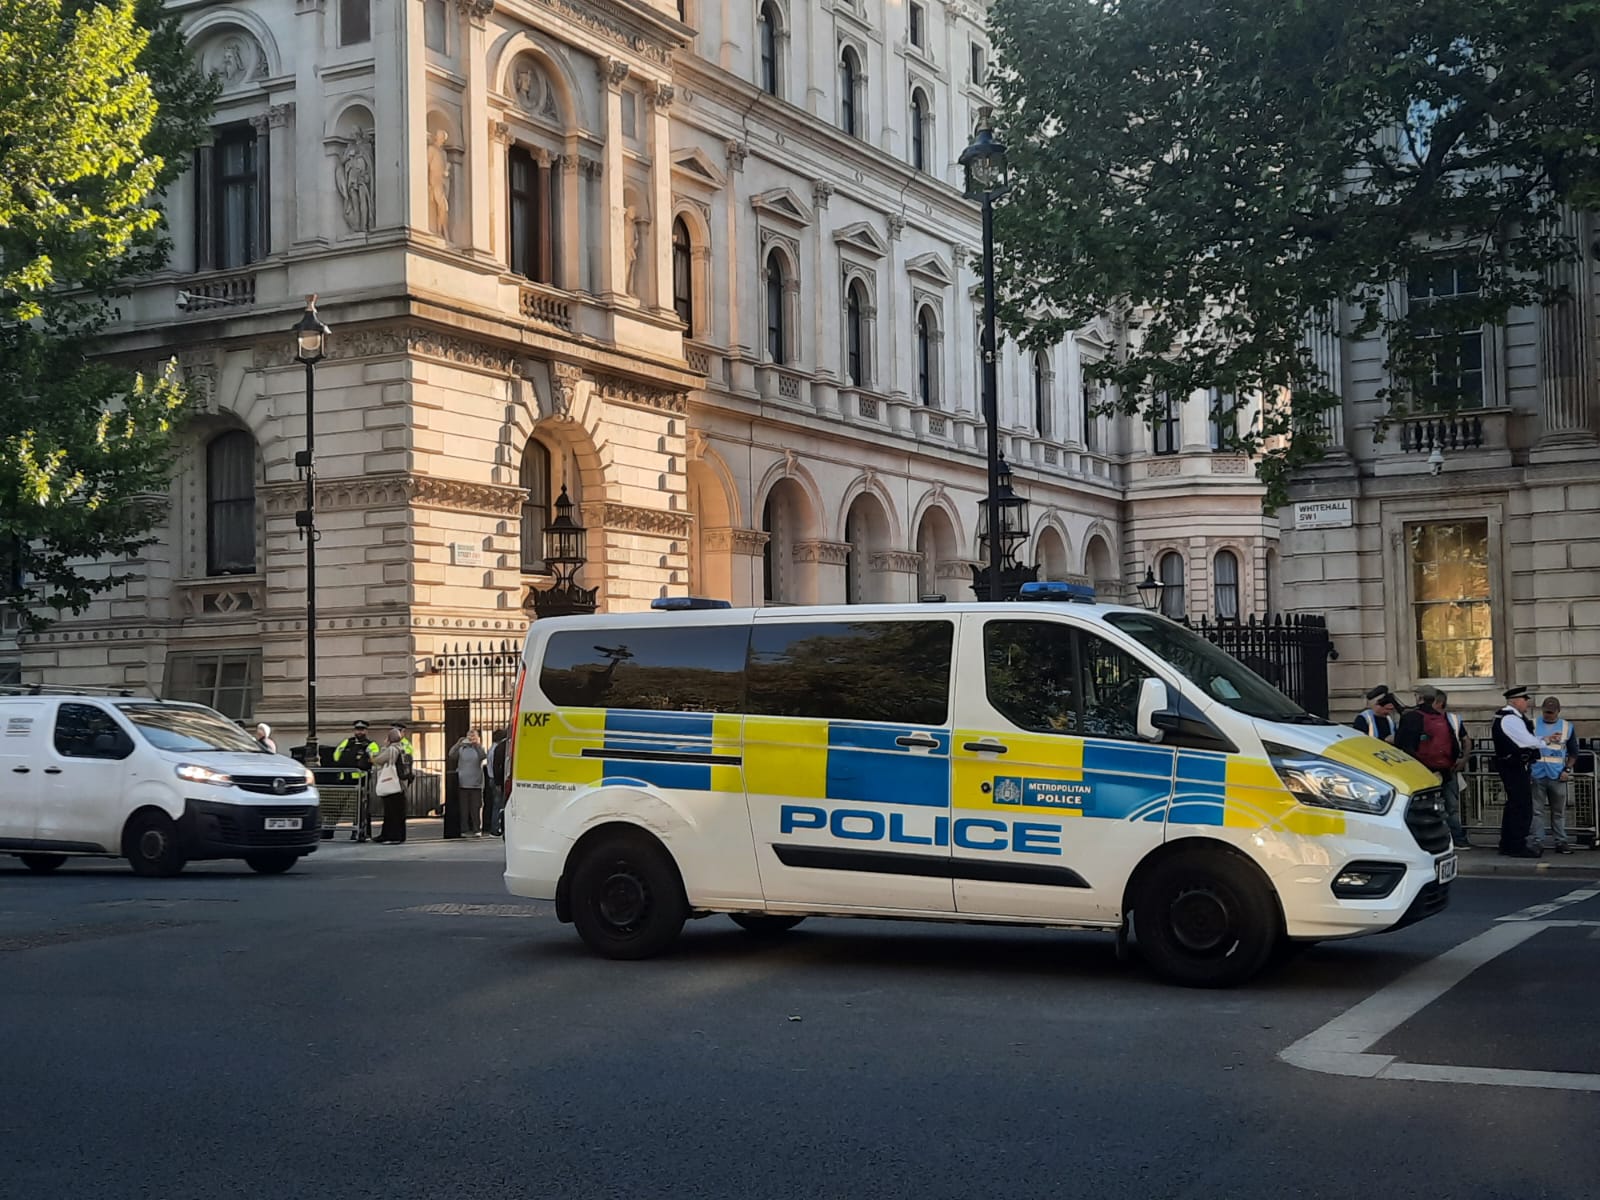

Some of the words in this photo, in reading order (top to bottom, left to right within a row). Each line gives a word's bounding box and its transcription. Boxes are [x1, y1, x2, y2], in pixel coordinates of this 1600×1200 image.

[1298, 502, 1348, 512] WHITEHALL
[1299, 512, 1317, 521] SW1
[523, 713, 551, 727] KXF
[515, 782, 577, 792] www.met.police.uk
[1028, 783, 1092, 794] METROPOLITAN
[1036, 793, 1082, 805] POLICE
[780, 804, 1062, 856] POLICE
